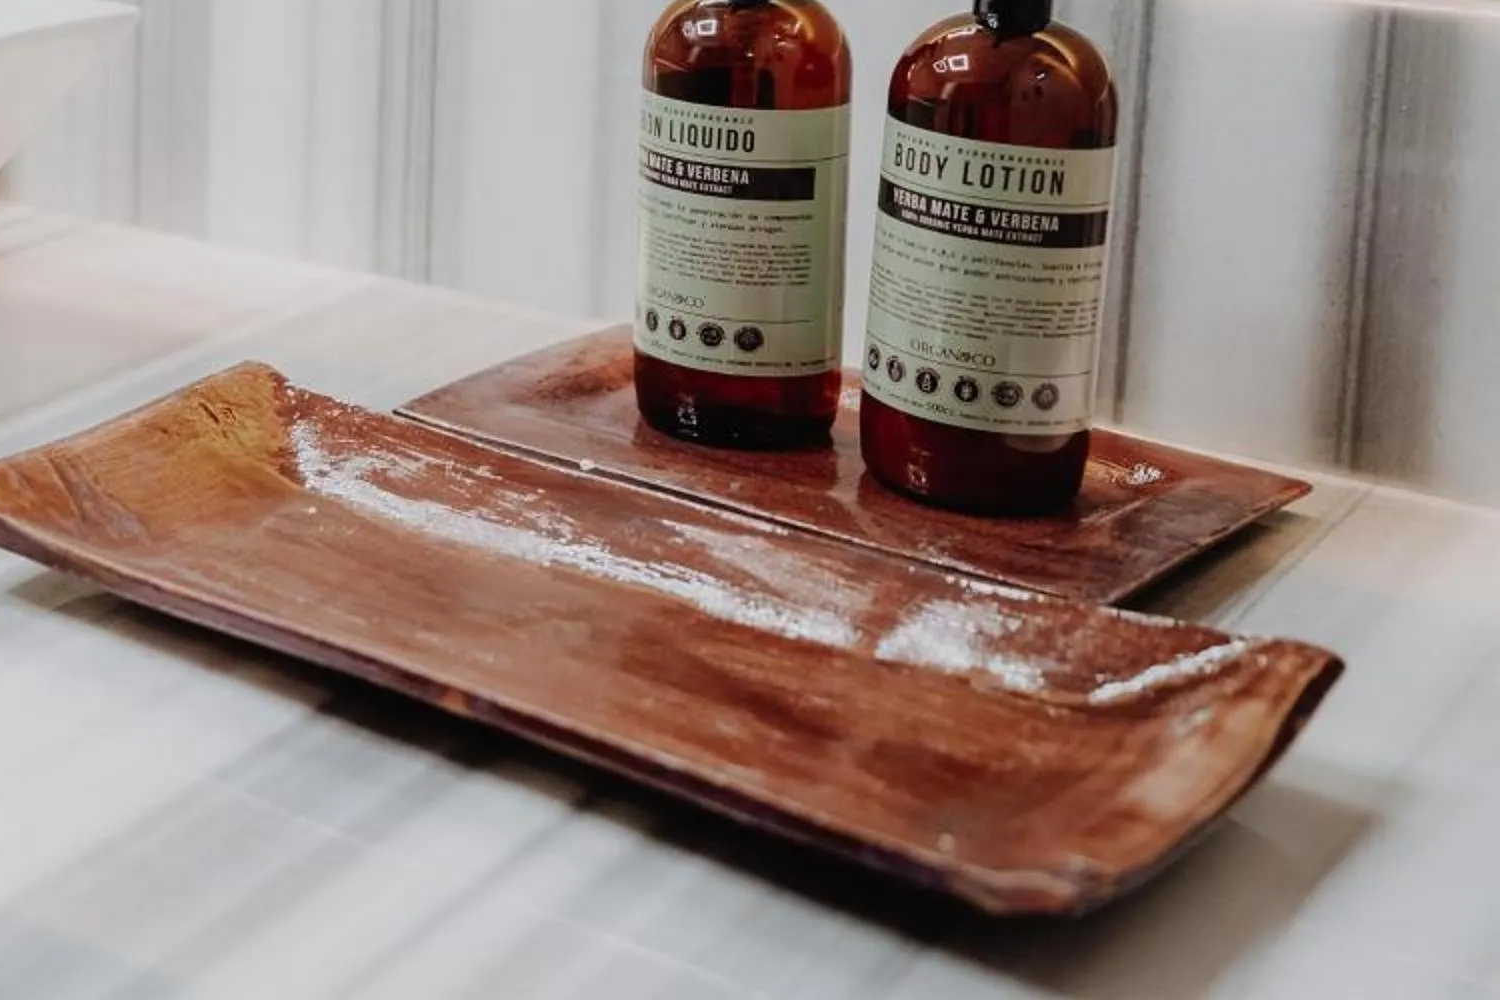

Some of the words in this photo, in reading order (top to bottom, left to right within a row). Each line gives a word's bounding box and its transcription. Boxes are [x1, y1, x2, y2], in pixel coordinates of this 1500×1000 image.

[669, 119, 755, 153] LIQUIDO
[675, 160, 685, 176] &
[687, 163, 750, 185] VERBENA
[893, 143, 949, 180] BODY
[962, 161, 1066, 196] LOTION
[892, 186, 928, 213] YERBA
[931, 199, 970, 222] MATE
[975, 210, 986, 225] &
[990, 211, 1060, 232] VERBENA
